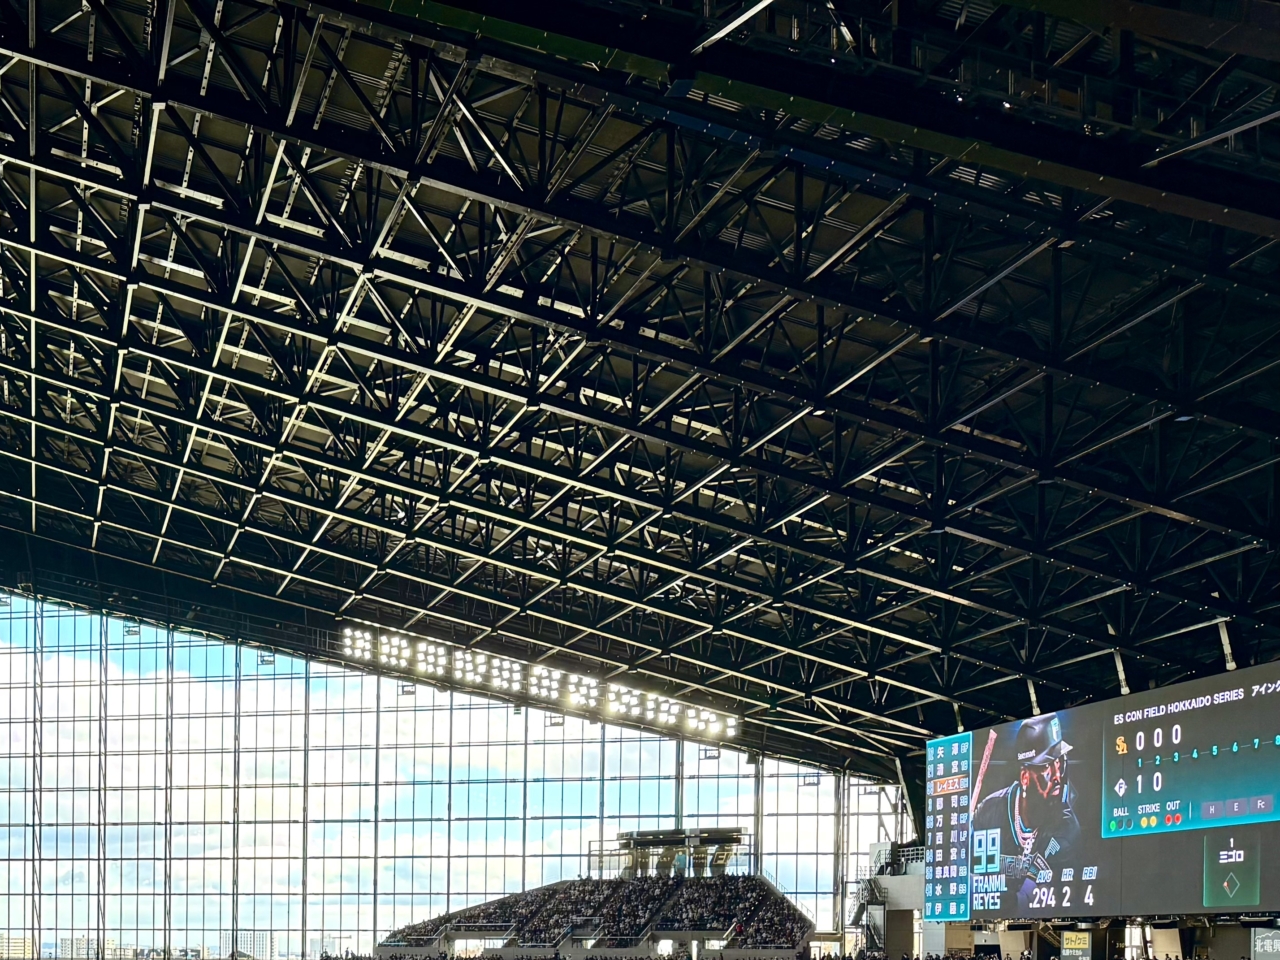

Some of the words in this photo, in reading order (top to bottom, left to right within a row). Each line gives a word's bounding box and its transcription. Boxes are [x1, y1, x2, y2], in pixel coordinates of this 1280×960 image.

[1114, 713, 1124, 725] ES
[1125, 709, 1143, 723] CON
[1144, 705, 1166, 719] FIELD
[1167, 695, 1212, 714] HOKKAIDO
[1213, 688, 1244, 705] SERIES
[1136, 731, 1144, 750] 0
[1154, 728, 1162, 747] 0
[1172, 724, 1181, 744] 0
[1138, 758, 1142, 768] 1
[1155, 755, 1161, 765] 2
[1173, 752, 1179, 762] 3
[1192, 749, 1198, 759] 4
[1212, 745, 1218, 756] 5
[1232, 742, 1238, 752] 6
[1253, 738, 1260, 749] 7
[937, 778, 959, 792] レイエス
[1136, 774, 1142, 794] 1
[1153, 772, 1162, 792] 0
[1113, 807, 1129, 817] BALL
[1138, 803, 1160, 815] STRIKE
[1166, 800, 1180, 811] OUT
[973, 827, 1001, 874] 99
[973, 873, 1008, 893] FRANMIL
[1037, 869, 1052, 883] AVG
[1061, 868, 1074, 881] HR
[1082, 866, 1098, 880] RBI
[973, 892, 1001, 910] REYES
[1029, 887, 1056, 908] .294
[1062, 885, 1071, 907] 2
[1084, 884, 1094, 906] 4
